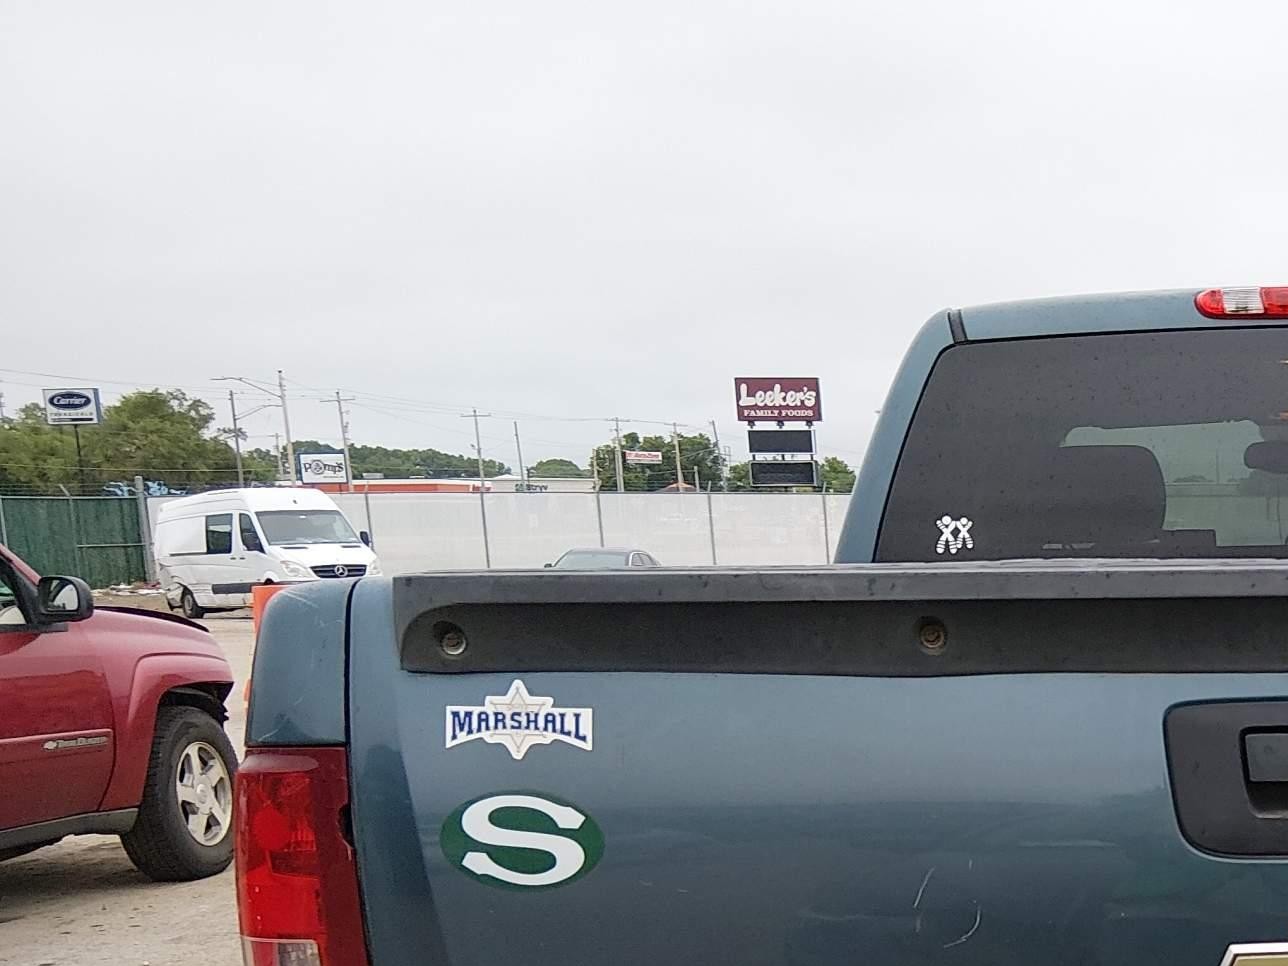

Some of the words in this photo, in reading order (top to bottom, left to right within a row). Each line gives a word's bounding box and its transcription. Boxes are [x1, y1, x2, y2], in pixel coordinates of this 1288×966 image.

[739, 383, 817, 407] Leeker's
[743, 409, 779, 417] FAMILY
[781, 409, 814, 417] FOODS
[450, 711, 588, 743] MARSHALL
[461, 794, 587, 886] S
